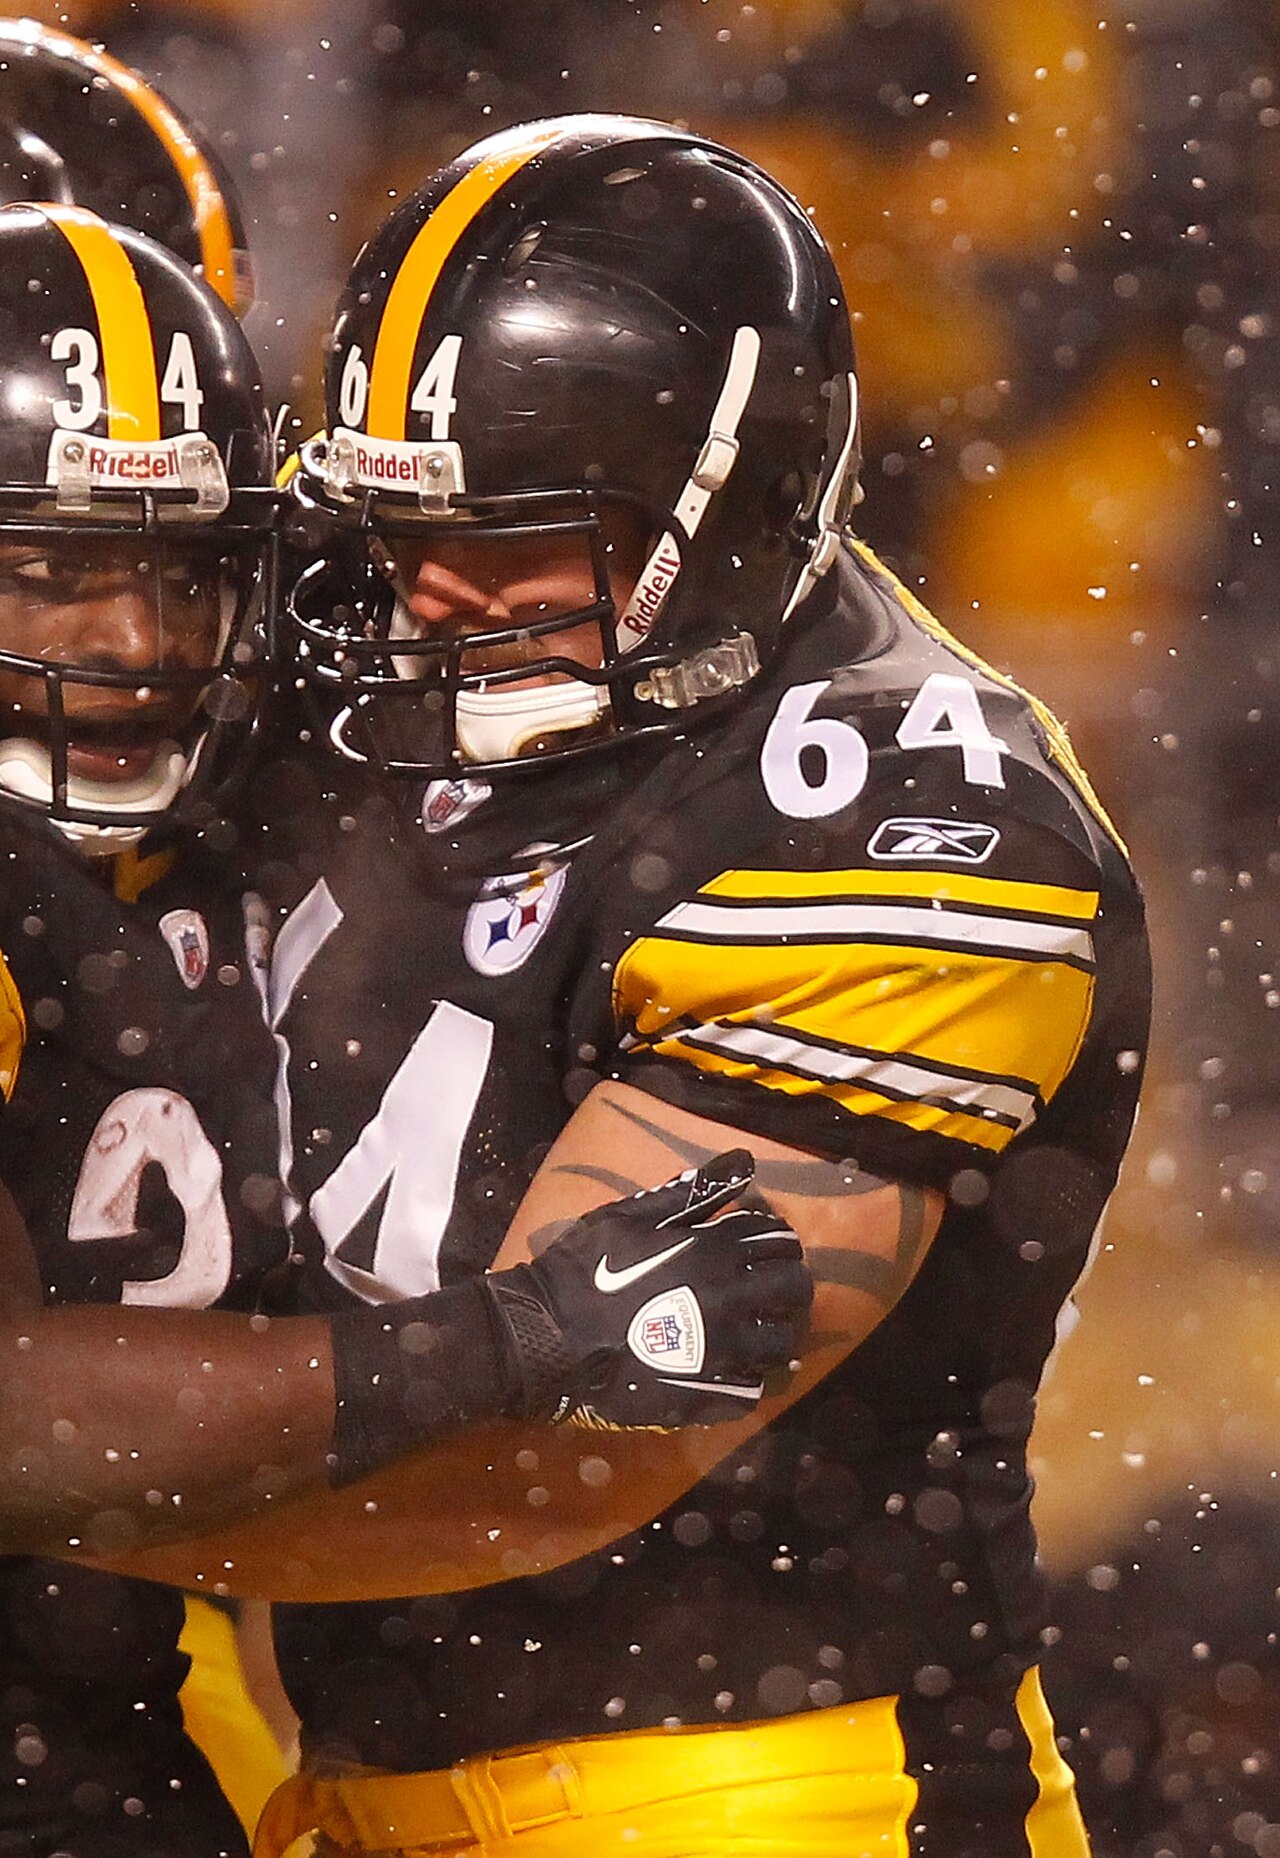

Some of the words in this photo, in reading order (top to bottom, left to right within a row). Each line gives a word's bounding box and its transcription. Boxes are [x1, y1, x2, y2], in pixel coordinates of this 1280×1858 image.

[89, 447, 180, 480] Riddell
[623, 556, 681, 635] Riddell
[760, 673, 1012, 819] 64
[645, 1321, 666, 1353] NFL
[675, 1297, 695, 1362] EQUIPMENT
